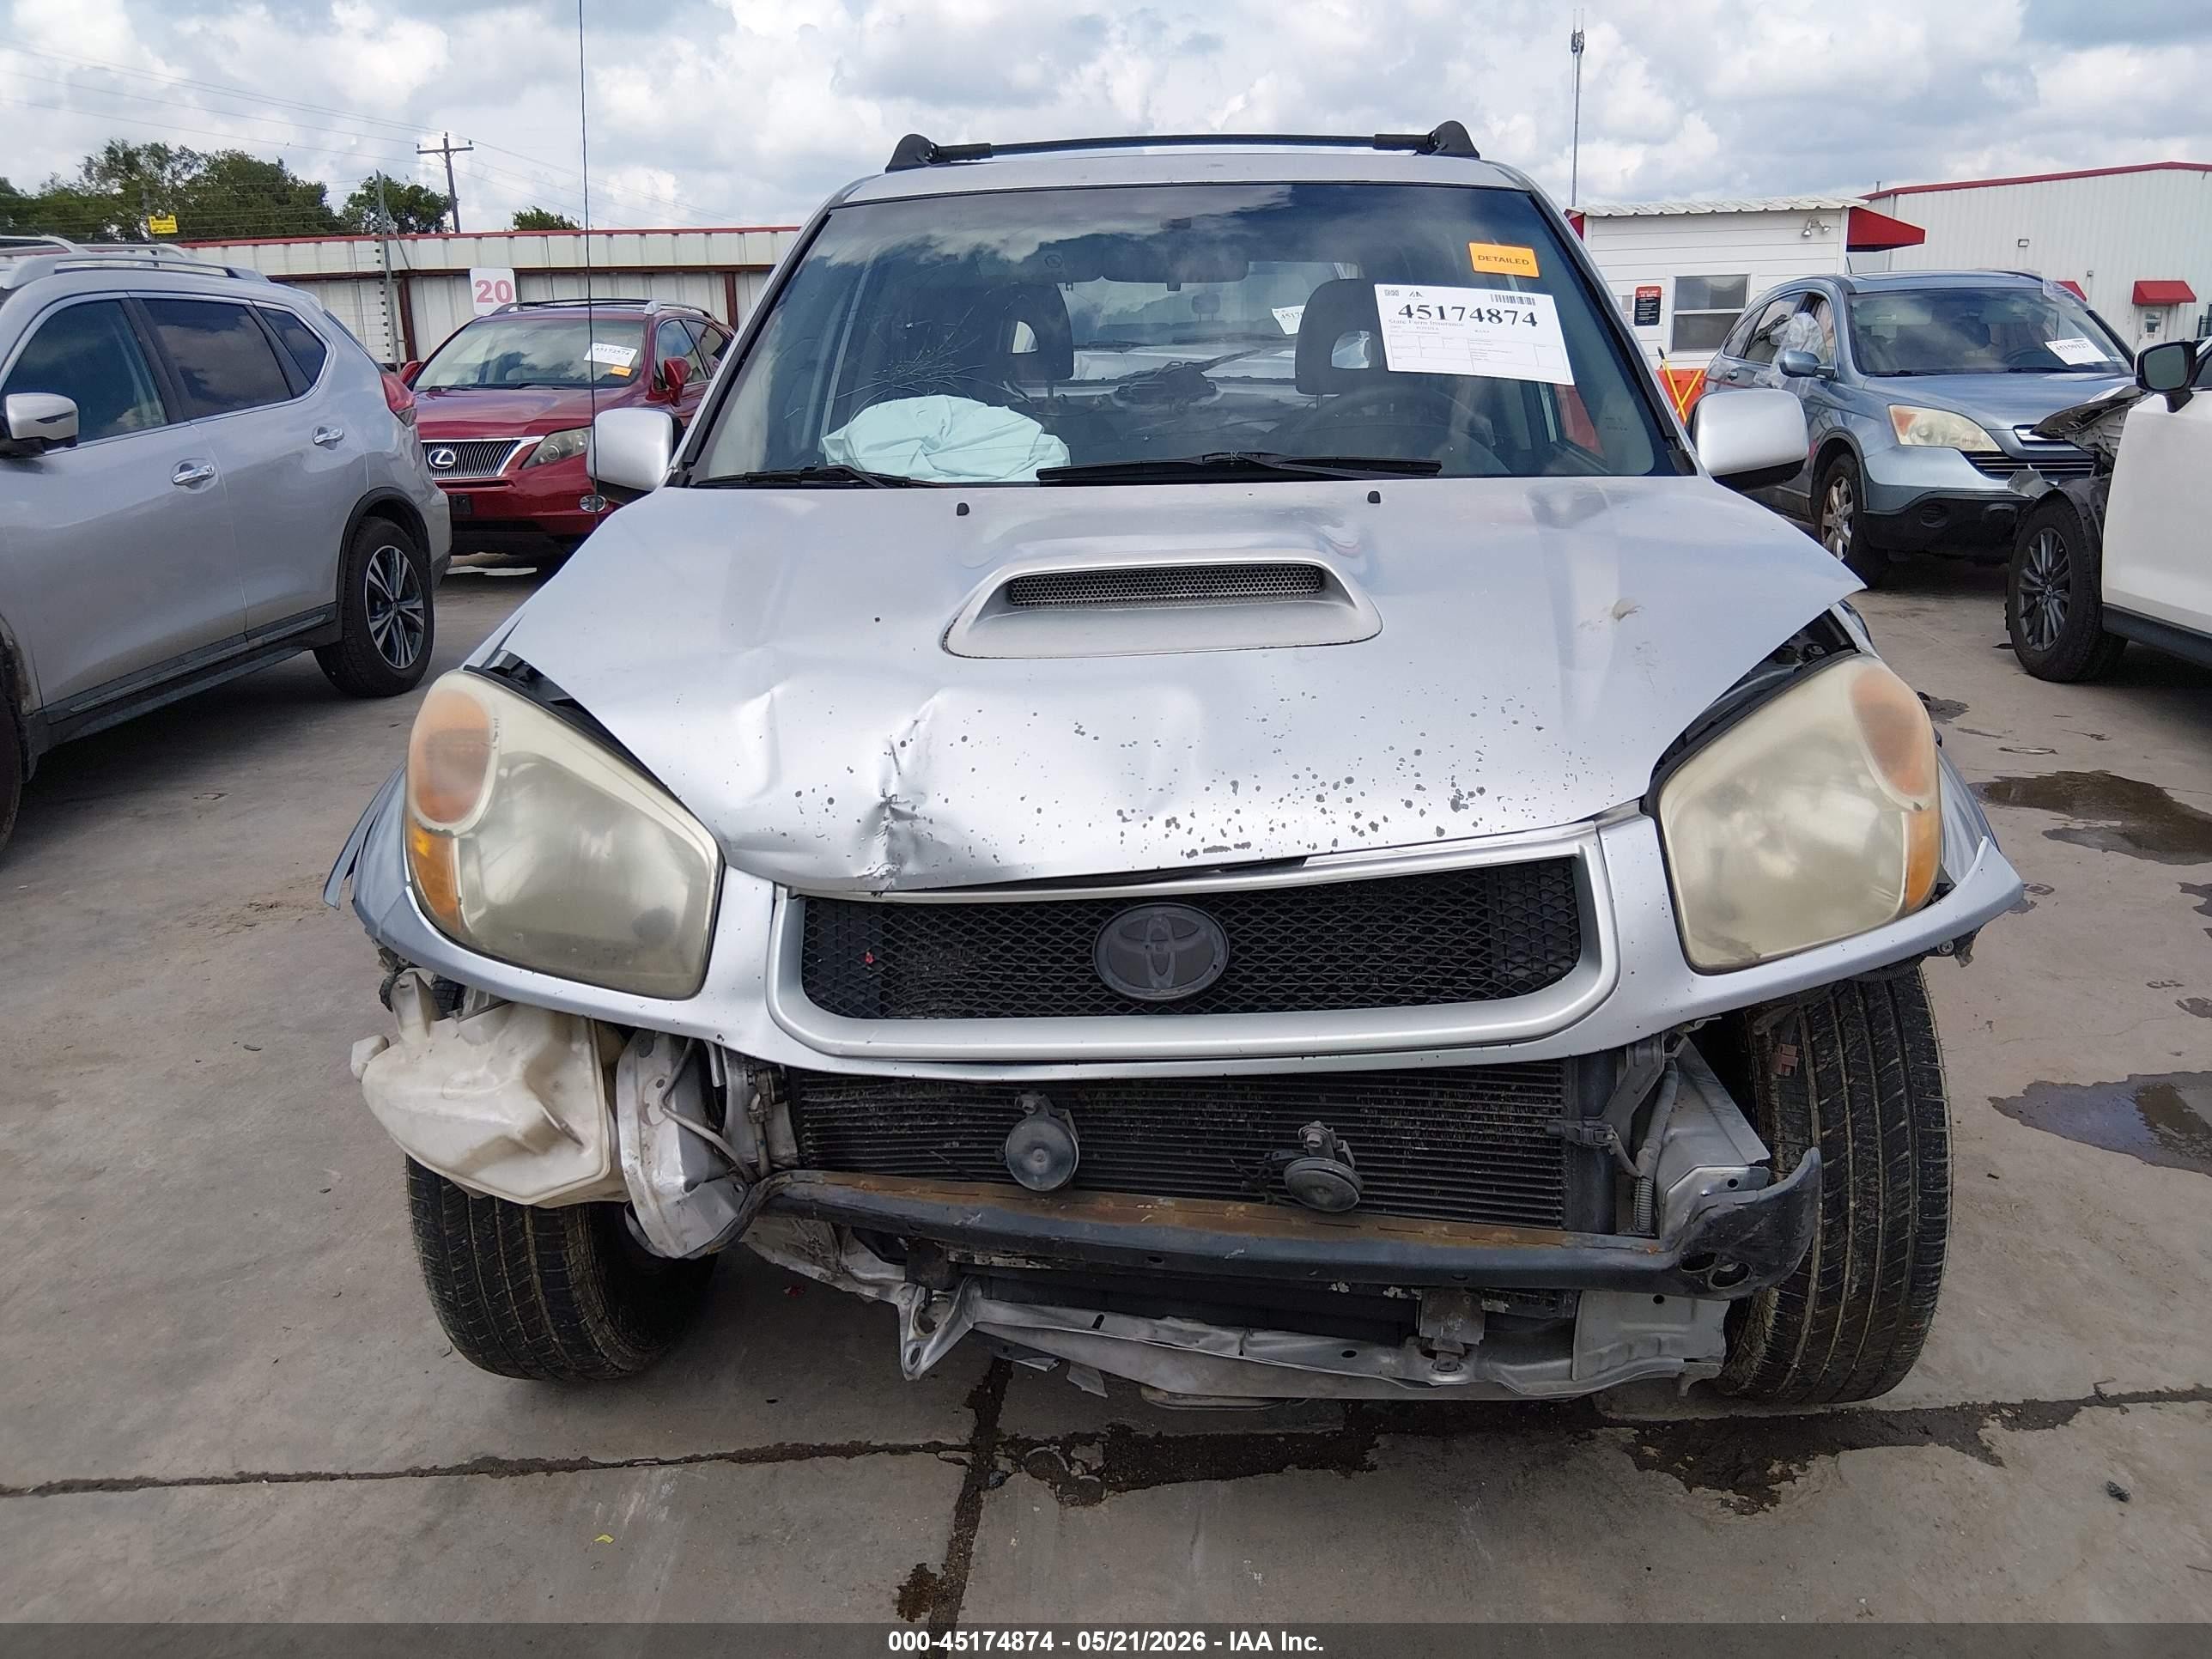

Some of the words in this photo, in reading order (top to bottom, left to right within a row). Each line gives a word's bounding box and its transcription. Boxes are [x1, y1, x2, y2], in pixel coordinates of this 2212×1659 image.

[1478, 255, 1530, 264] DETAILED
[475, 279, 513, 303] 20
[1398, 304, 1538, 327] 45174874
